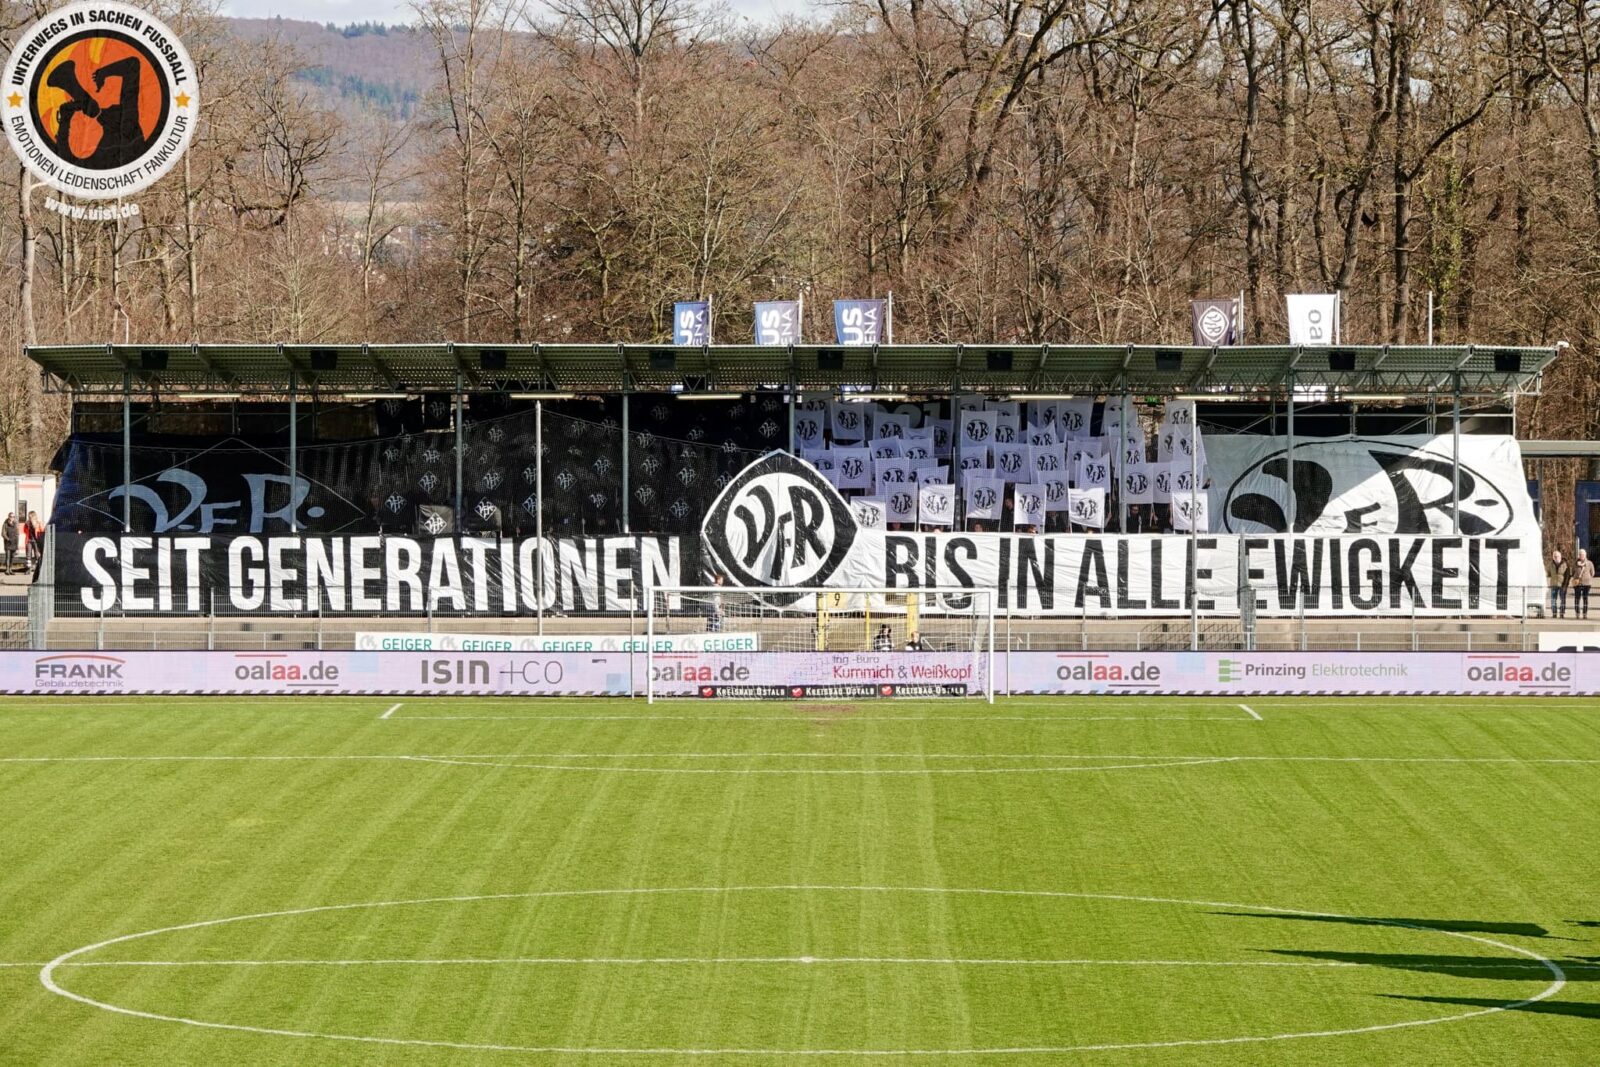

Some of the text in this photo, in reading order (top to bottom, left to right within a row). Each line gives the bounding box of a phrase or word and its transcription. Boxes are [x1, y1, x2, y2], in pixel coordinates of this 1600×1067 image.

[80, 535, 682, 612] SEIT GENERATIONEN
[885, 535, 1521, 611] BIS IN ALLE EWIGKEIT
[382, 638, 432, 651] GEIGER
[462, 640, 512, 651] GEIGER
[542, 641, 592, 651] GEIGER
[703, 637, 754, 651] GEIGER
[35, 663, 123, 679] FRANK
[235, 660, 339, 680] oalaa.de
[832, 665, 973, 683] Kummich & Weißkopf
[1057, 661, 1161, 681] oalaa.de
[1245, 663, 1408, 679] Prinzing Elektrotechnik
[1468, 662, 1572, 682] oalaa.de
[35, 679, 124, 688] Gebäudetechnik
